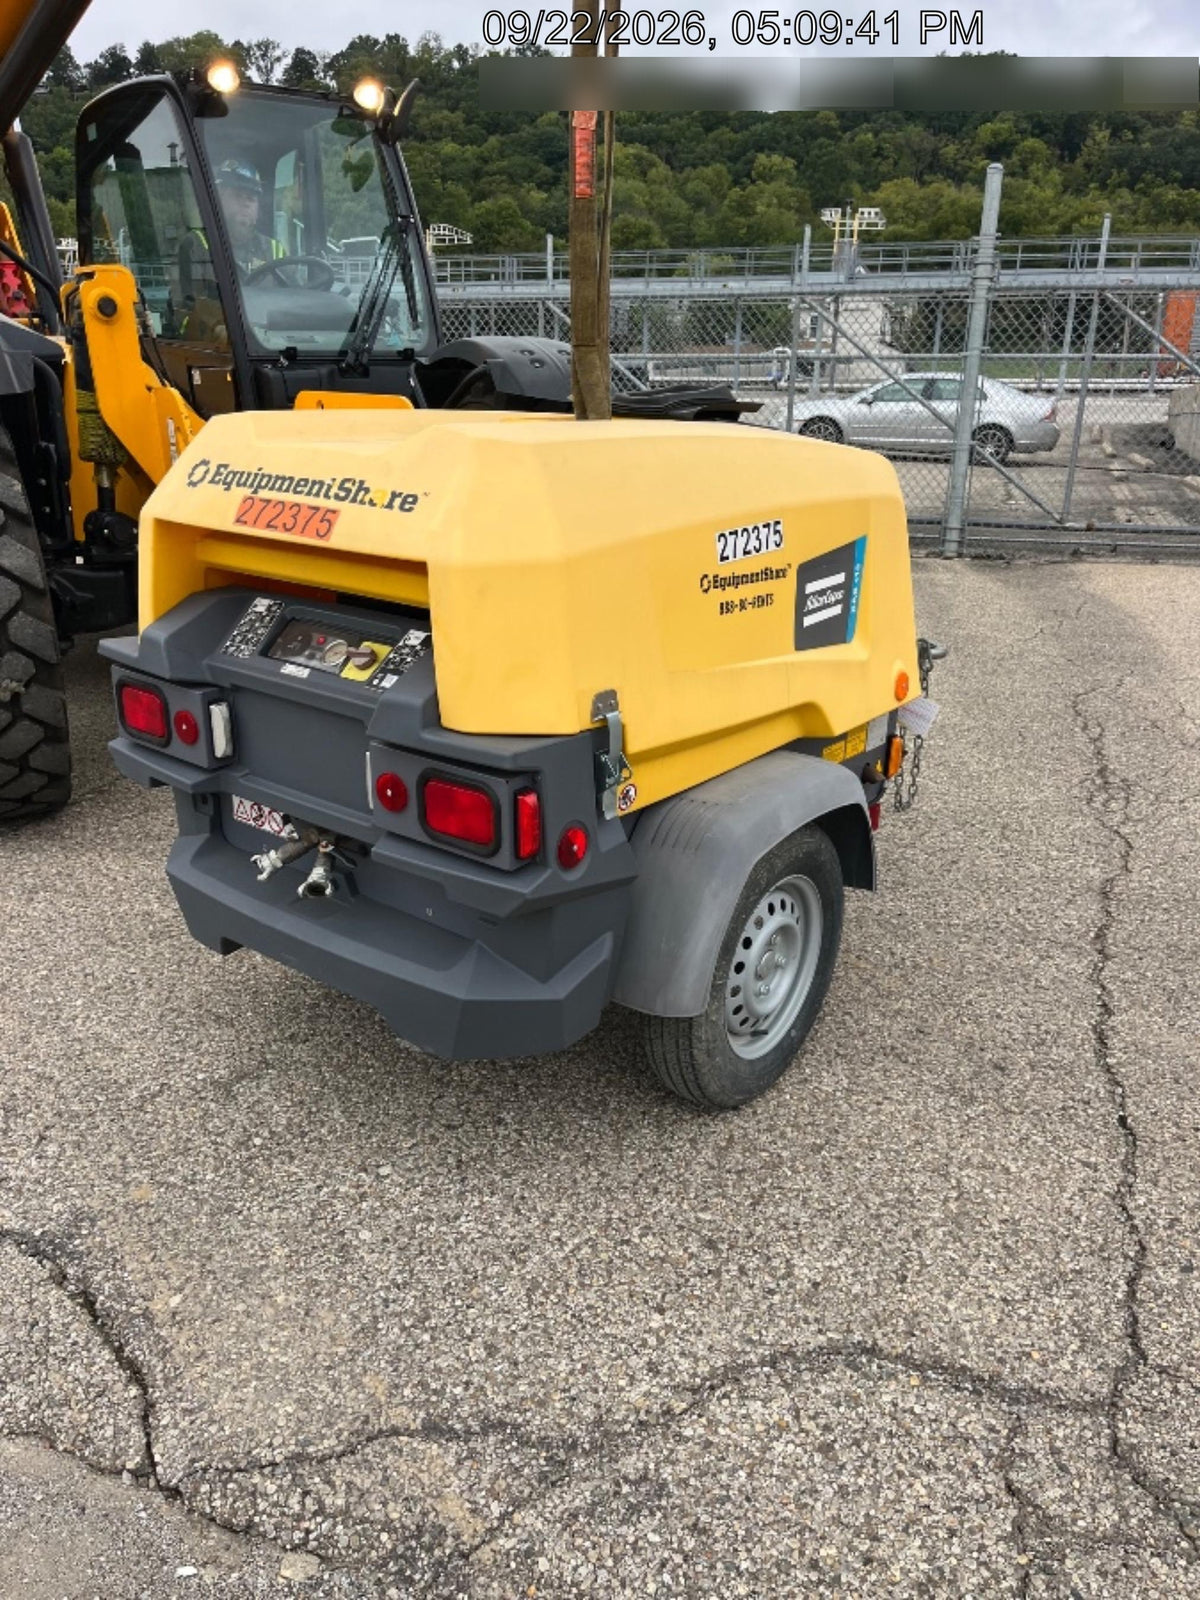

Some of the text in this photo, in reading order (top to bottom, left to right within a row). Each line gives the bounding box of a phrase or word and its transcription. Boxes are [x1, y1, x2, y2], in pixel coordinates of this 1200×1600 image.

[234, 495, 338, 540] 272375
[717, 520, 784, 563] 272375
[712, 566, 788, 591] EquipmentShare
